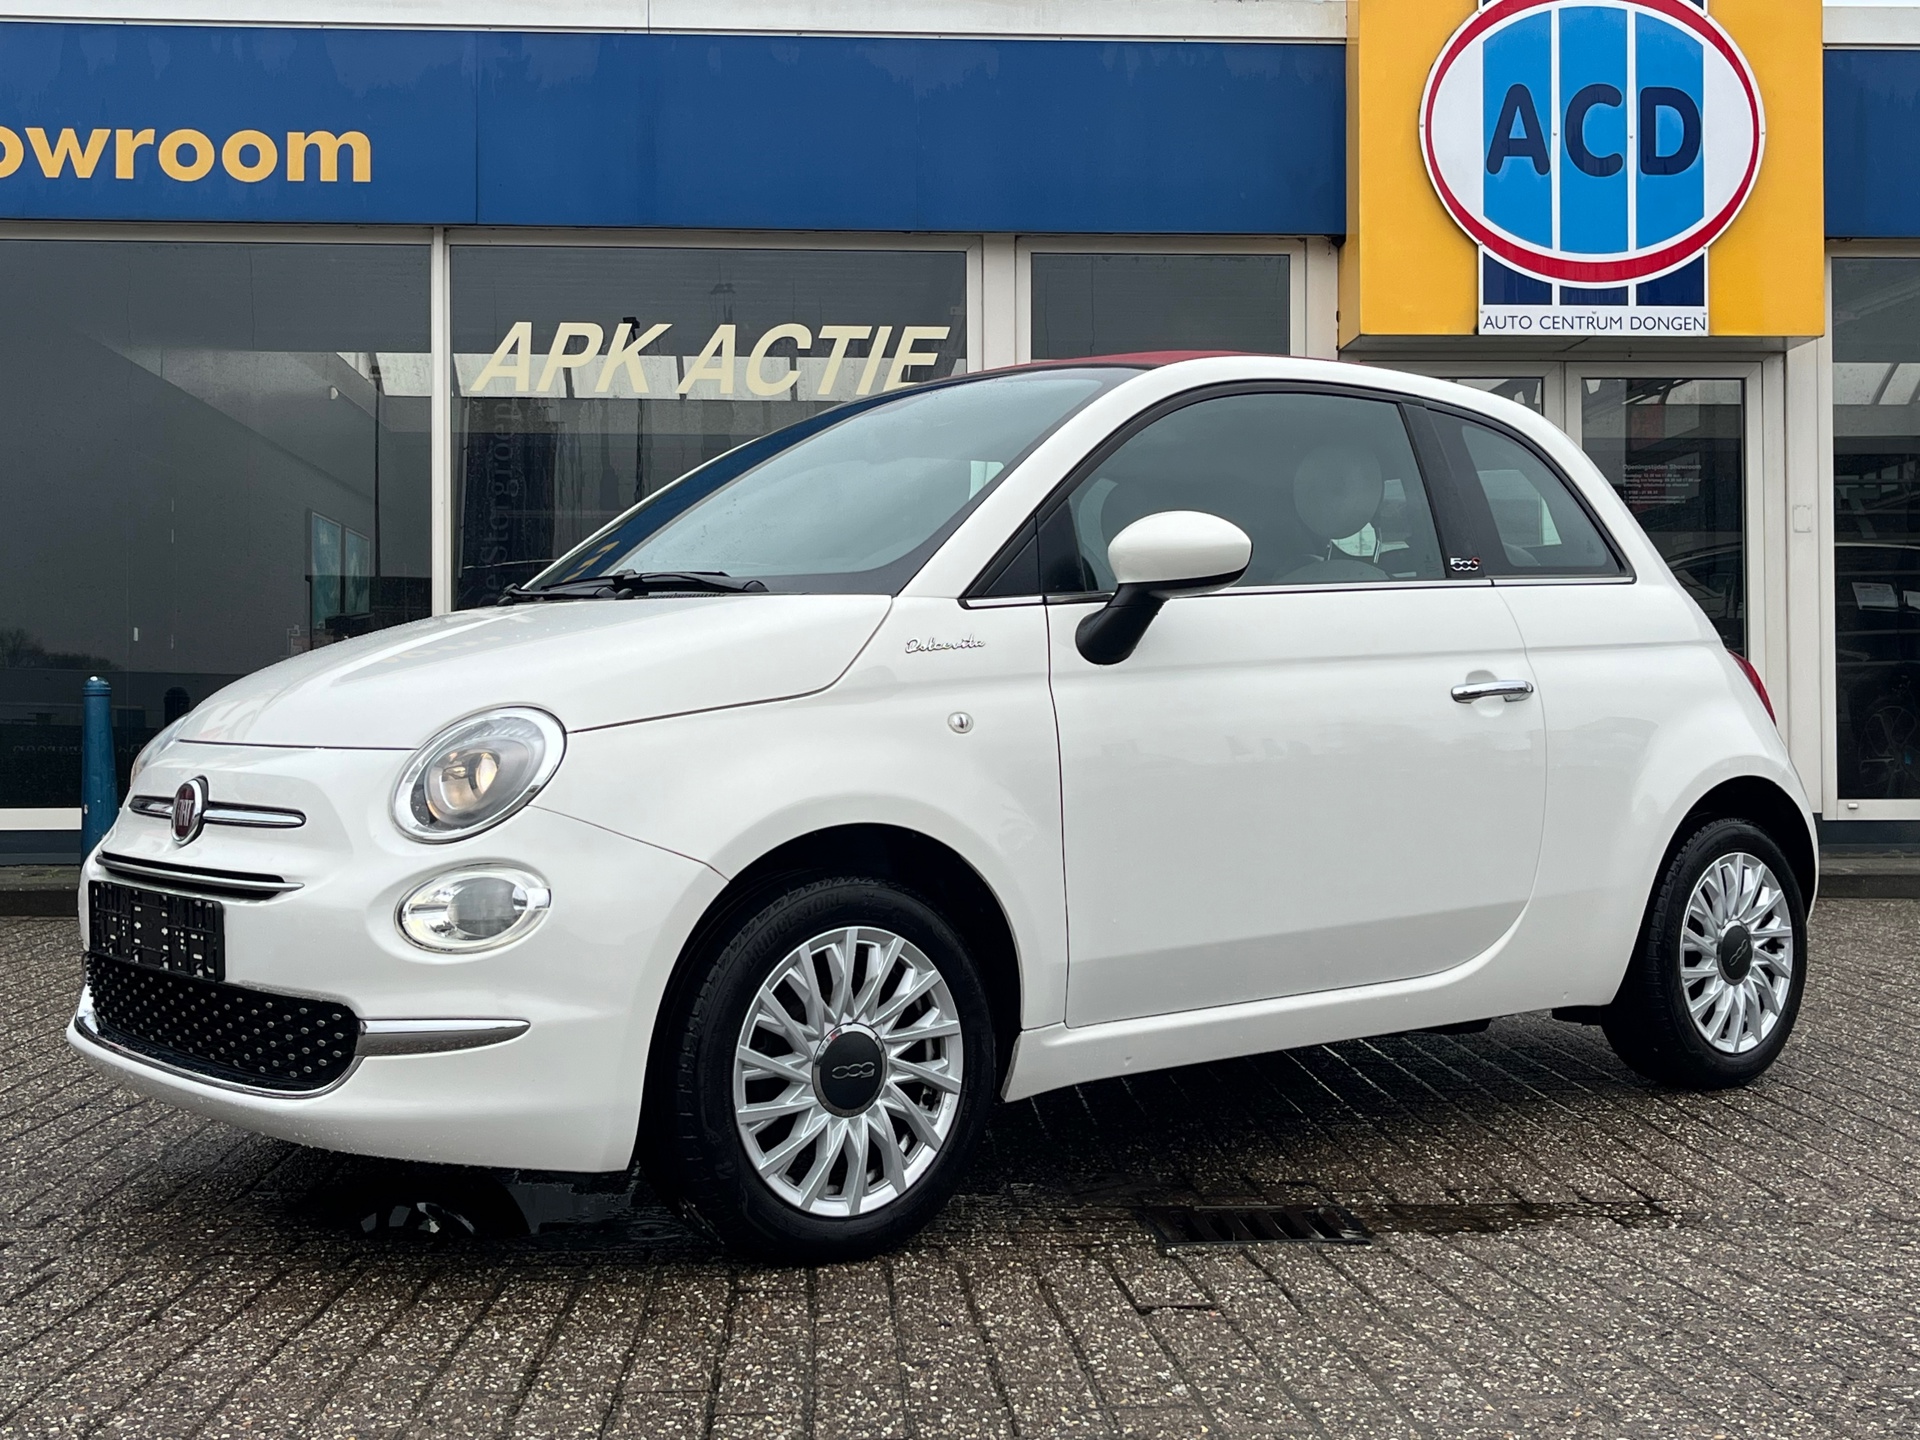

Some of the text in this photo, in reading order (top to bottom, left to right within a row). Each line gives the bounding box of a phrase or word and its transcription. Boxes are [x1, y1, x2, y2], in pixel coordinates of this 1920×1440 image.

[1486, 83, 1702, 178] ACD
[470, 321, 951, 396] APK ACTIE
[1483, 315, 1707, 332] AUTO CENTRUM DONGEN
